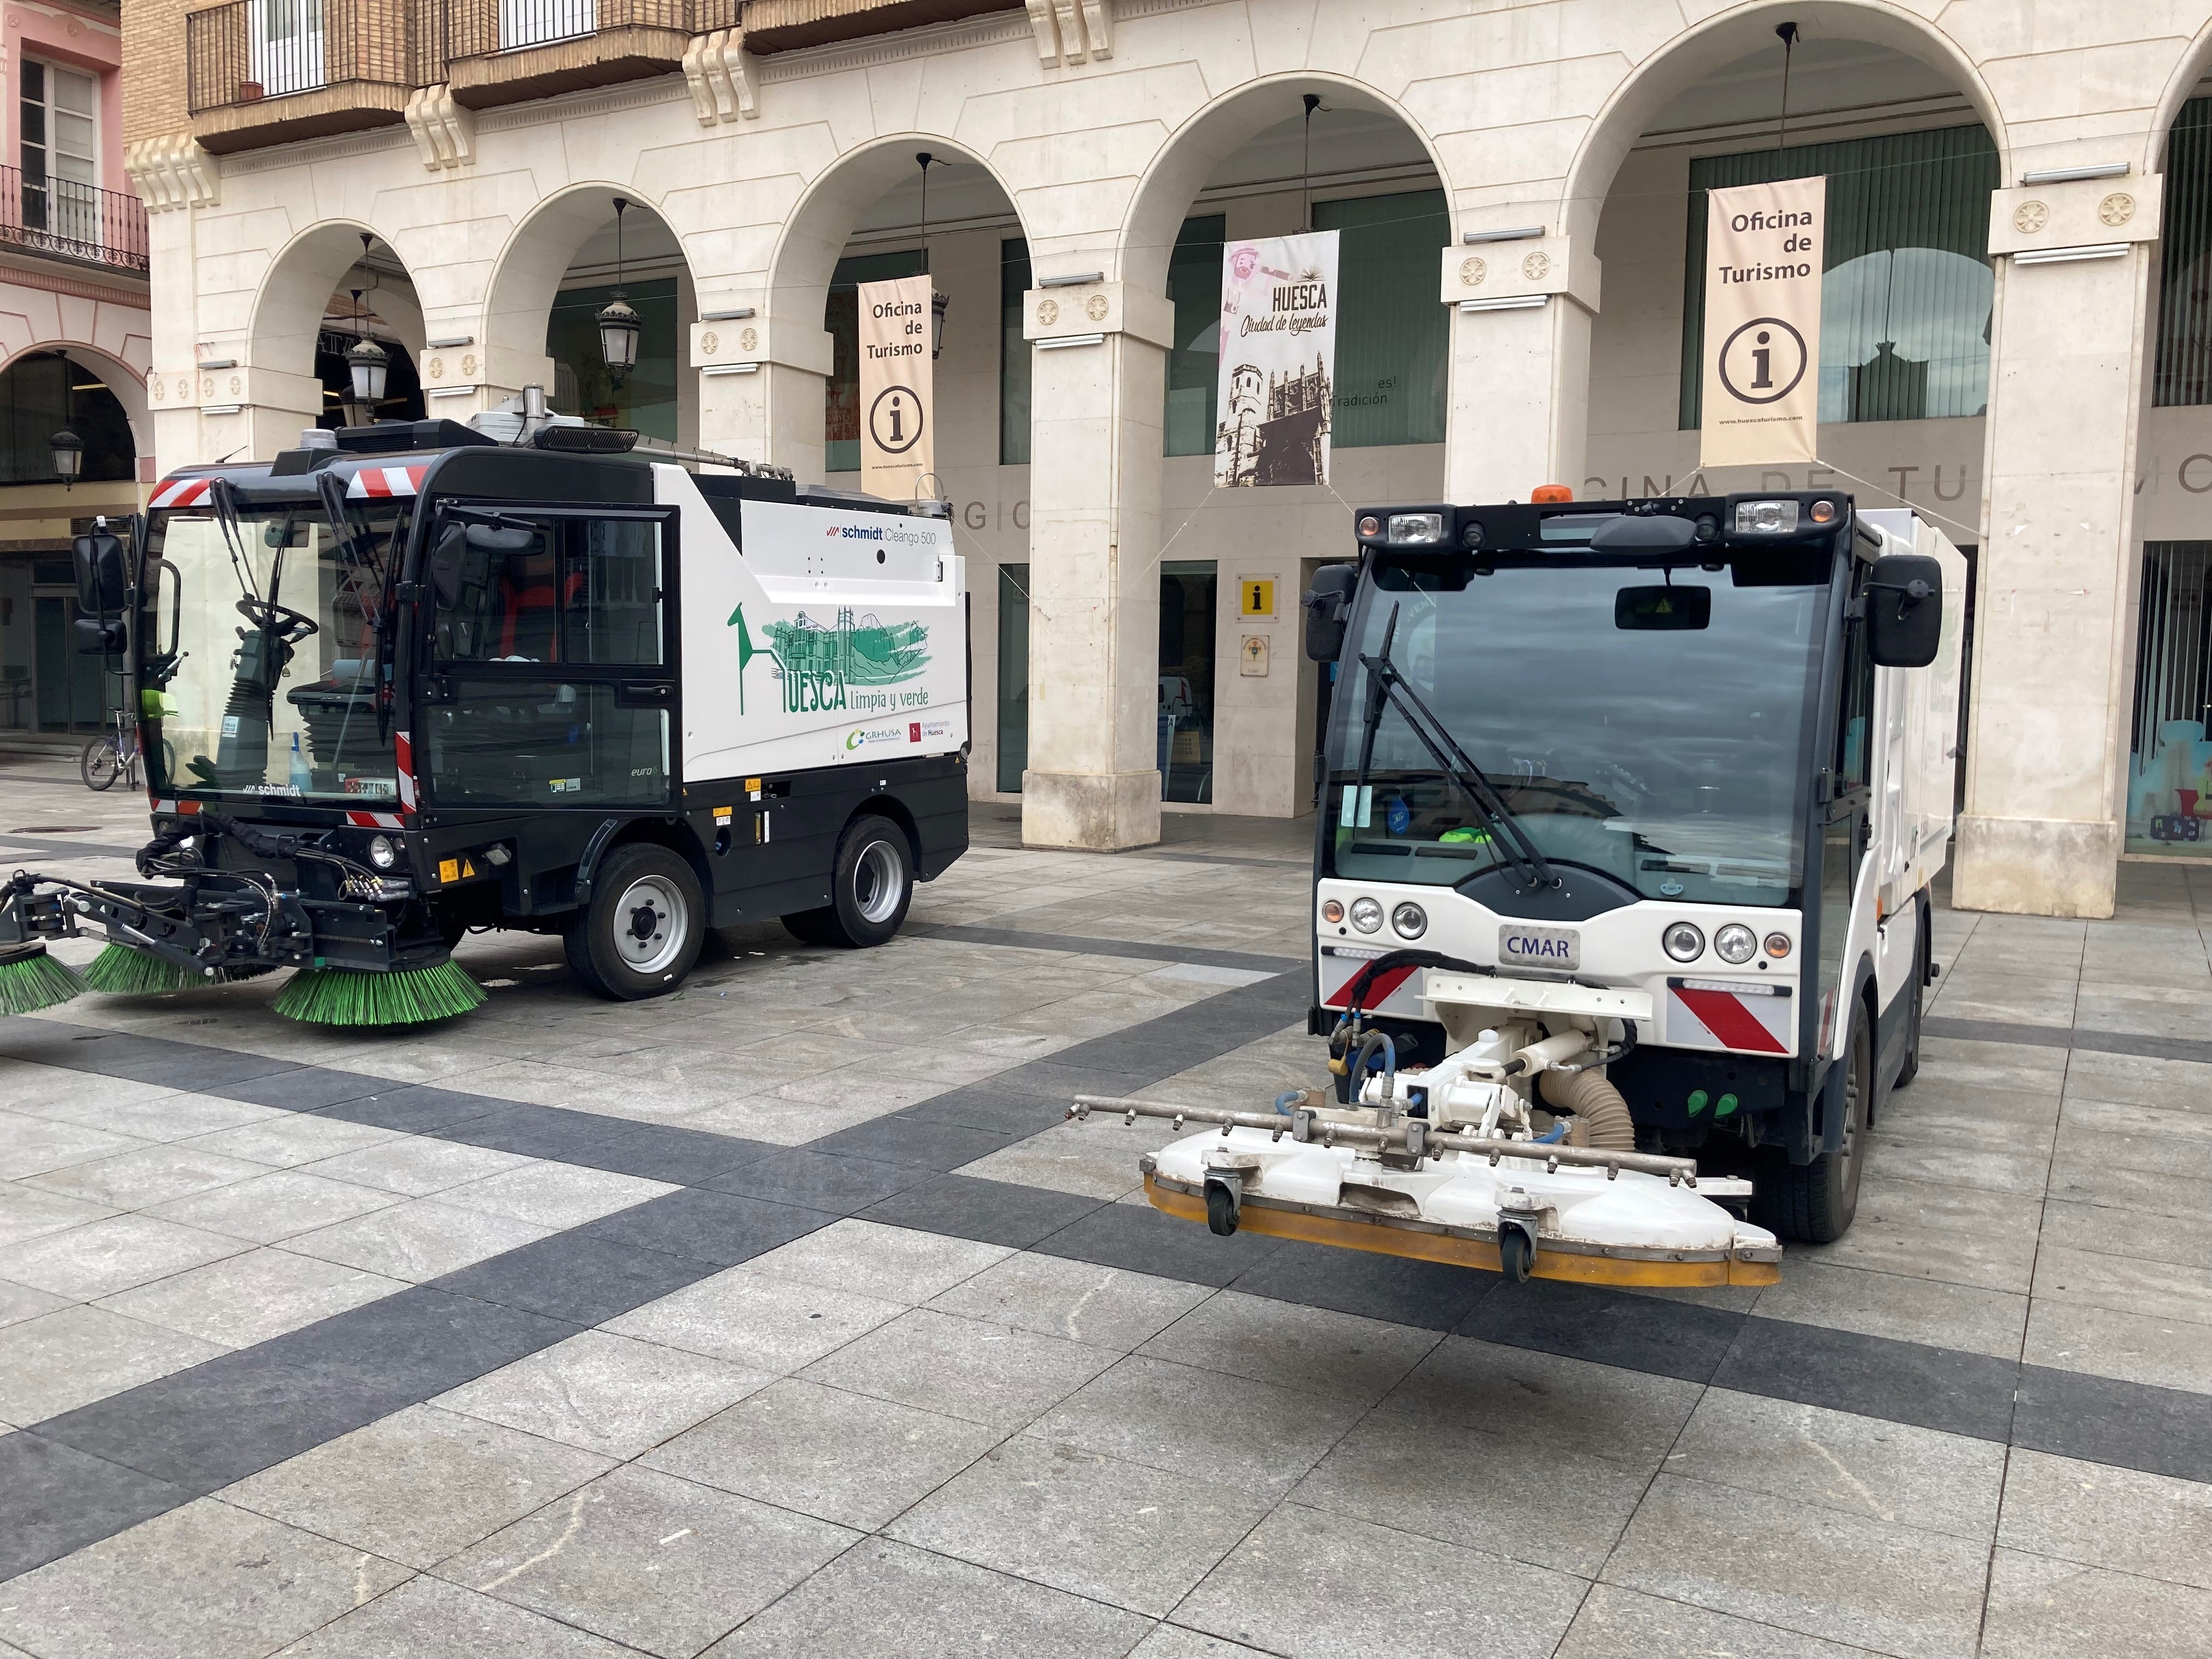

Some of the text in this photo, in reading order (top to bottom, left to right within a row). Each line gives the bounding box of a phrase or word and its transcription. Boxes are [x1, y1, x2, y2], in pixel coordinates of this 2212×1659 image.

[1731, 210, 1812, 232] Oficina
[1784, 233, 1812, 252] de
[1719, 262, 1810, 284] Turismo
[1272, 283, 1327, 312] HUESCA
[873, 301, 922, 318] Oficina
[905, 320, 922, 335] de
[1240, 312, 1329, 337] Ciudad de leyendas
[866, 342, 923, 359] Turismo
[1378, 375, 1396, 388] es!
[1333, 391, 1387, 407] Tradición
[1719, 416, 1803, 425] www.huescaturismo.com
[842, 525, 936, 546] schmidt Cleango 500
[890, 692, 896, 711] y
[900, 687, 929, 706] verde
[922, 721, 950, 729] Ayuntamiento
[865, 729, 901, 740] GRHUSA
[257, 783, 301, 797] schmidt
[1507, 936, 1569, 958] CMAR
